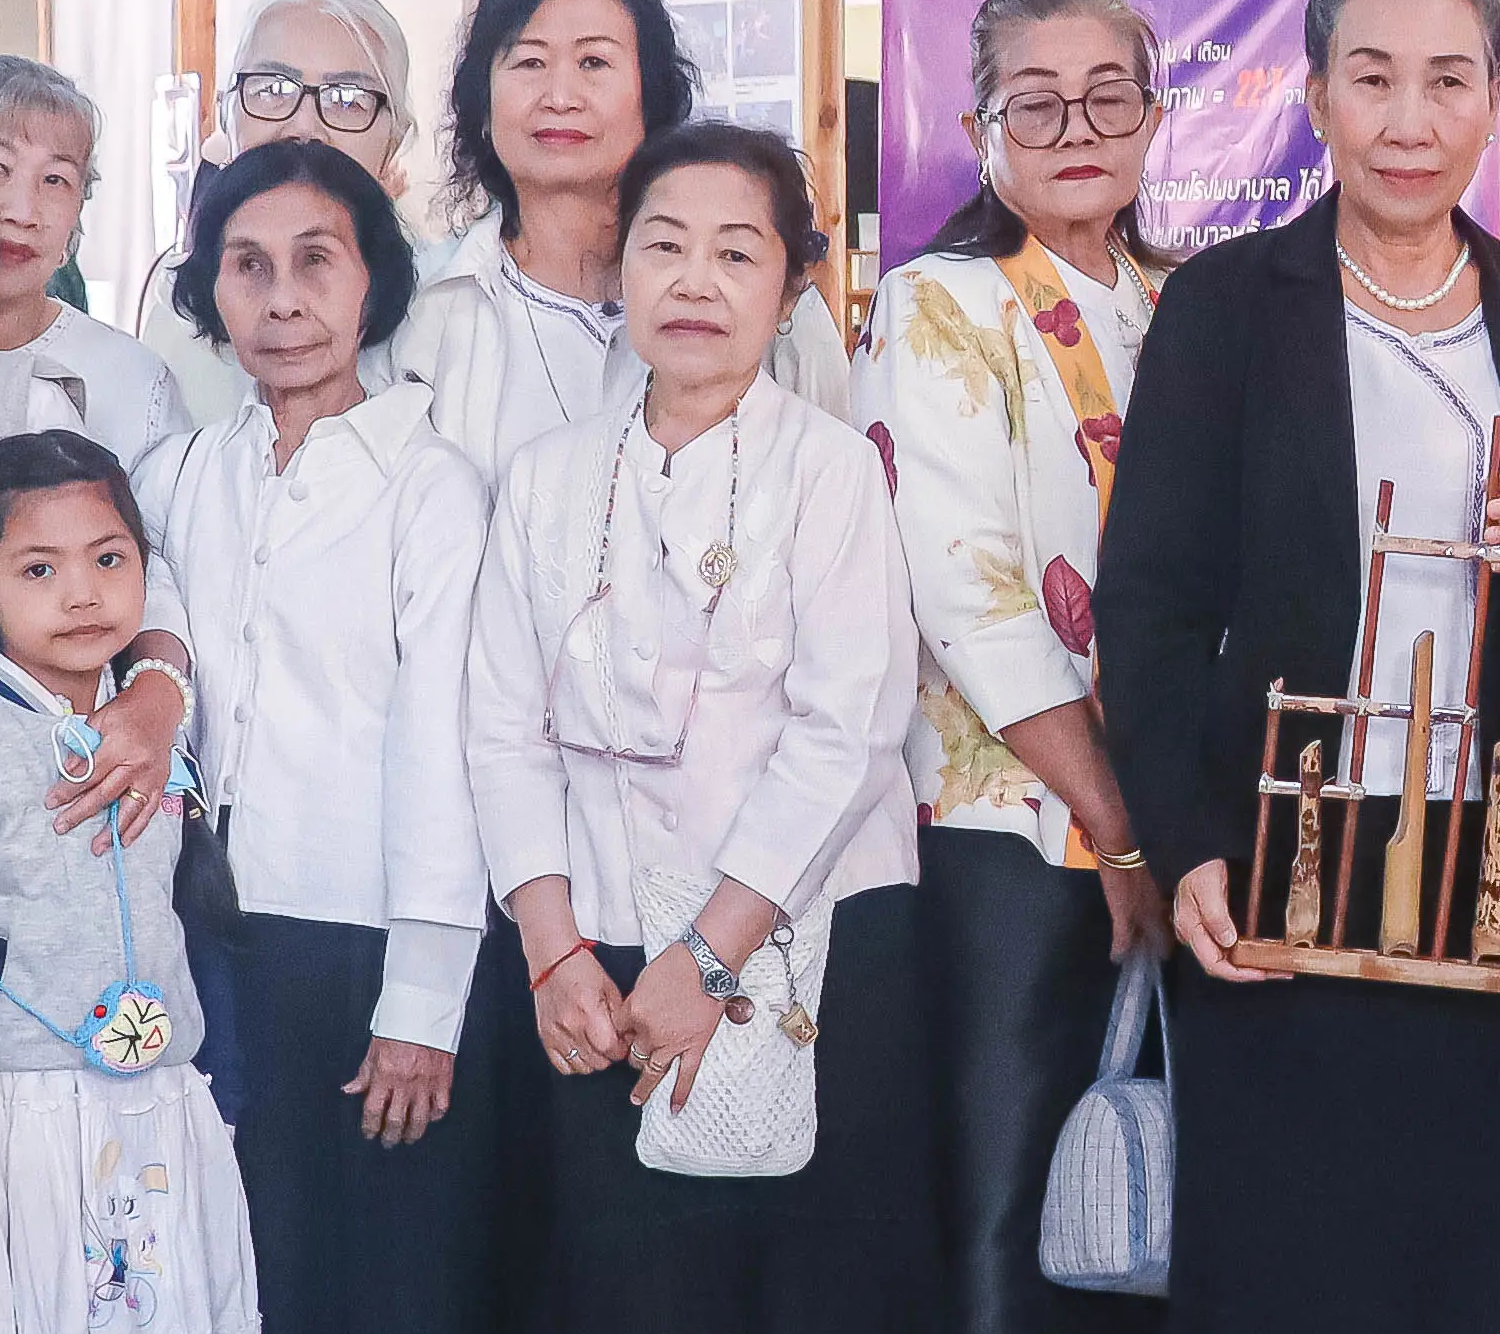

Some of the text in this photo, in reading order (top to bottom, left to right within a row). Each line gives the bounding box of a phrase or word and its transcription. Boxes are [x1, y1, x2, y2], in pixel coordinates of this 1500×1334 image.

[1180, 42, 1193, 63] 4
[1196, 38, 1234, 63] เดือน
[1299, 167, 1324, 202] ได้
